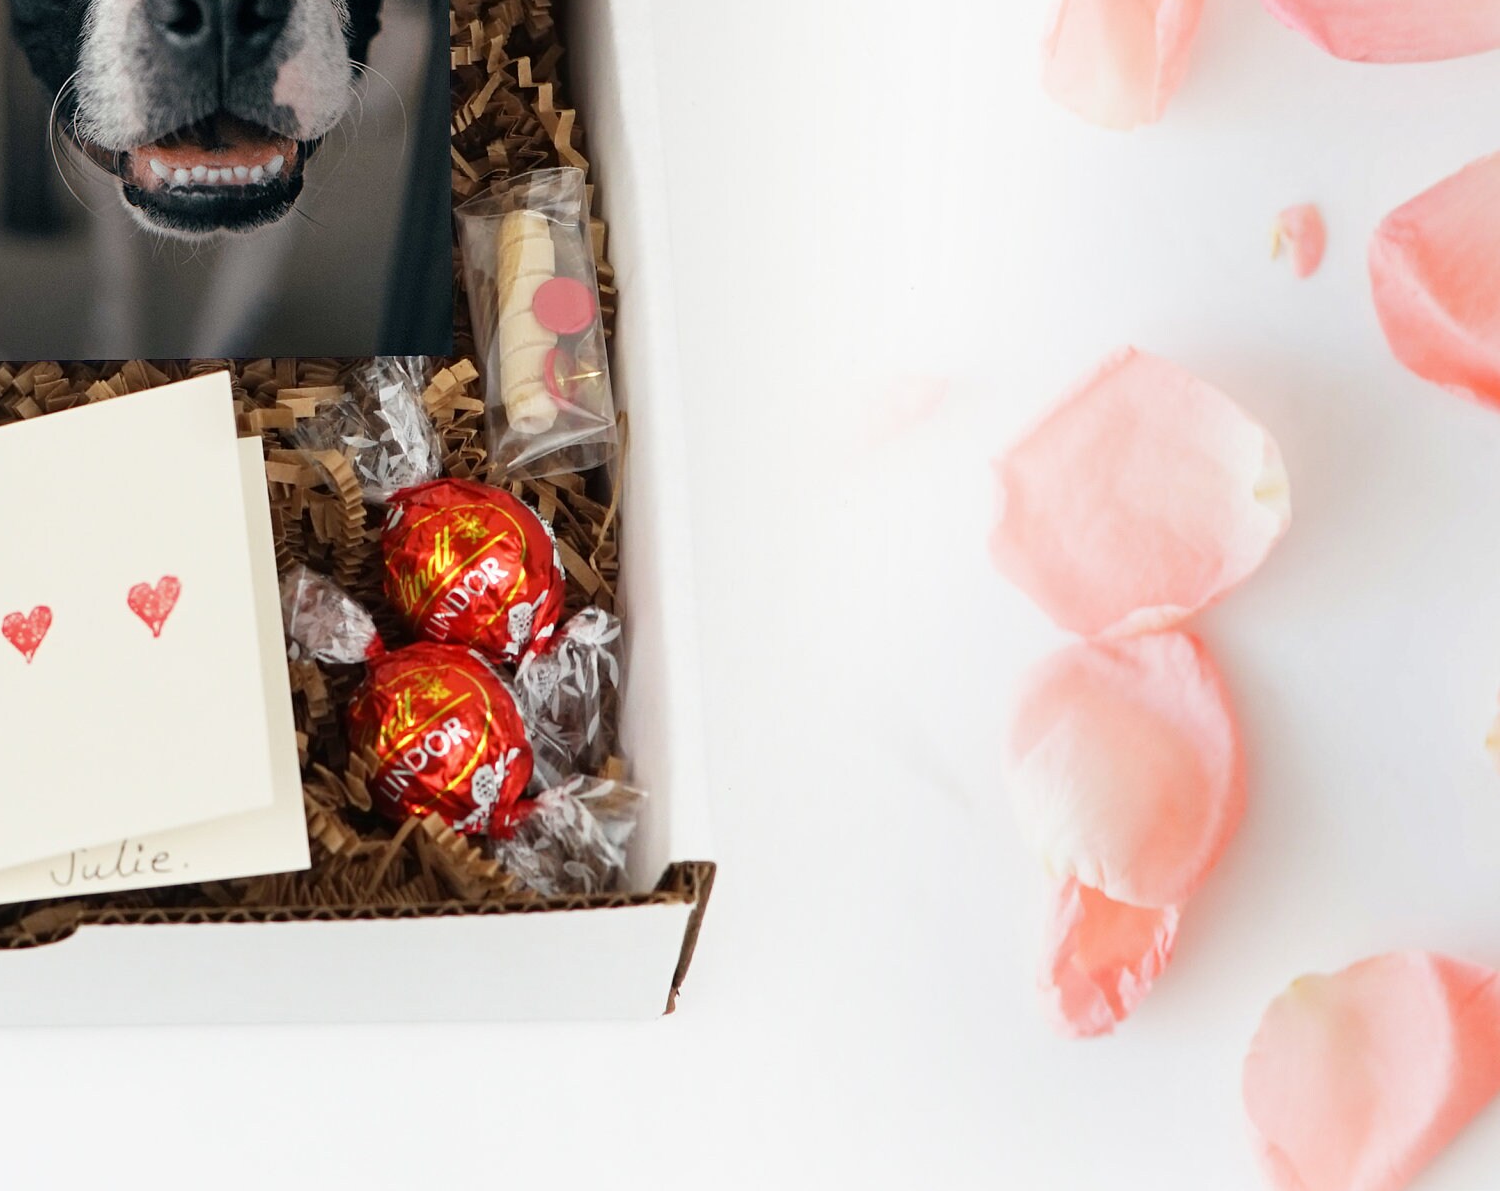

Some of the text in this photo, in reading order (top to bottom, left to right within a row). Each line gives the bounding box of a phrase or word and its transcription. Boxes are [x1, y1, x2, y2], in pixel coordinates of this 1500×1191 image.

[393, 526, 456, 616] Lindt
[425, 557, 509, 641] LINDOR
[380, 717, 471, 803] LINDOR
